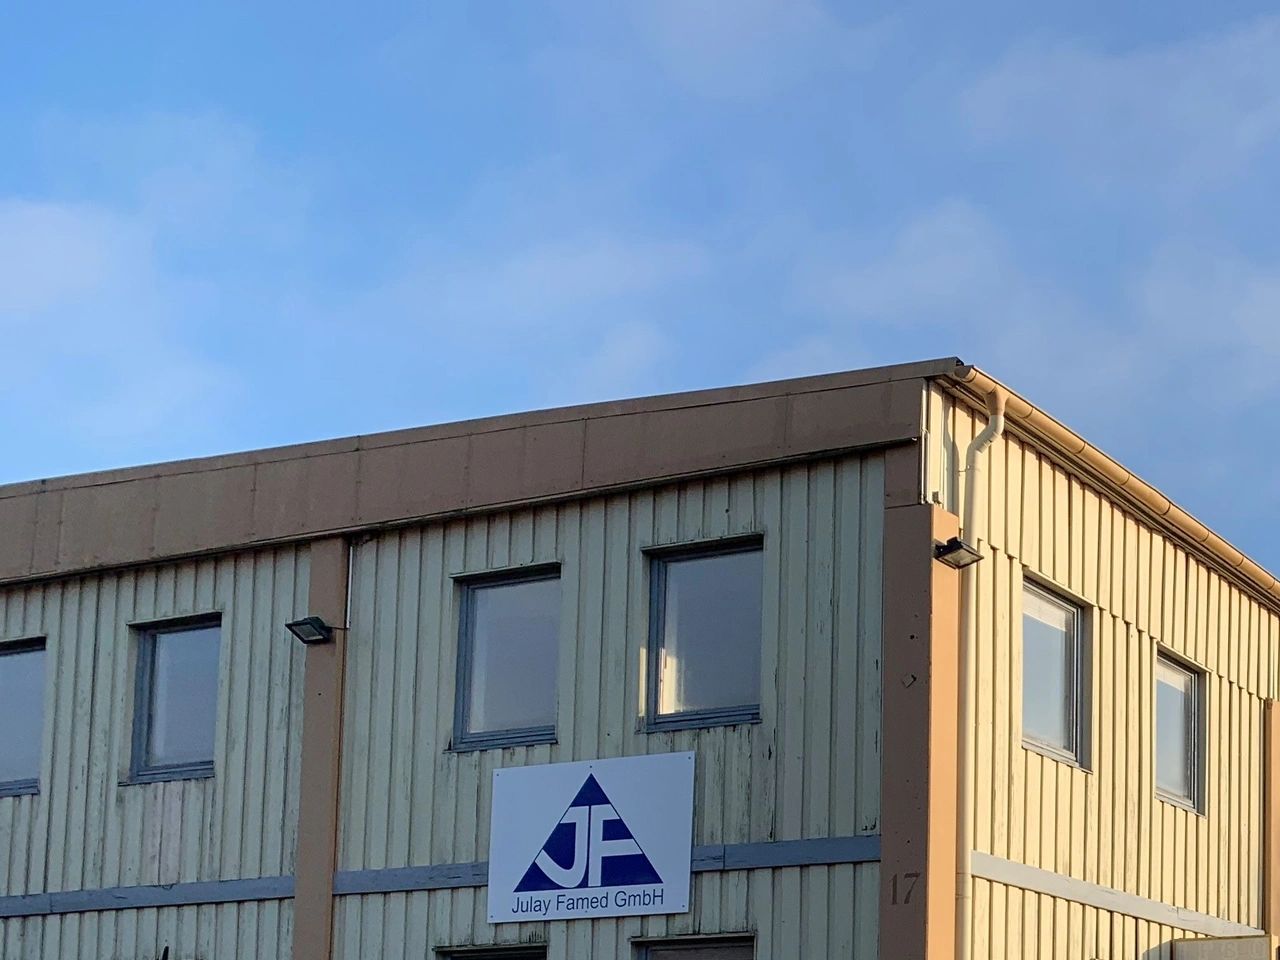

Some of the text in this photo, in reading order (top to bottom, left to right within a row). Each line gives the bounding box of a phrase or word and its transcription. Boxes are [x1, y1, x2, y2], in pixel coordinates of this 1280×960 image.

[512, 888, 664, 916] Julay Famed GmbH
[890, 873, 920, 905] 17
